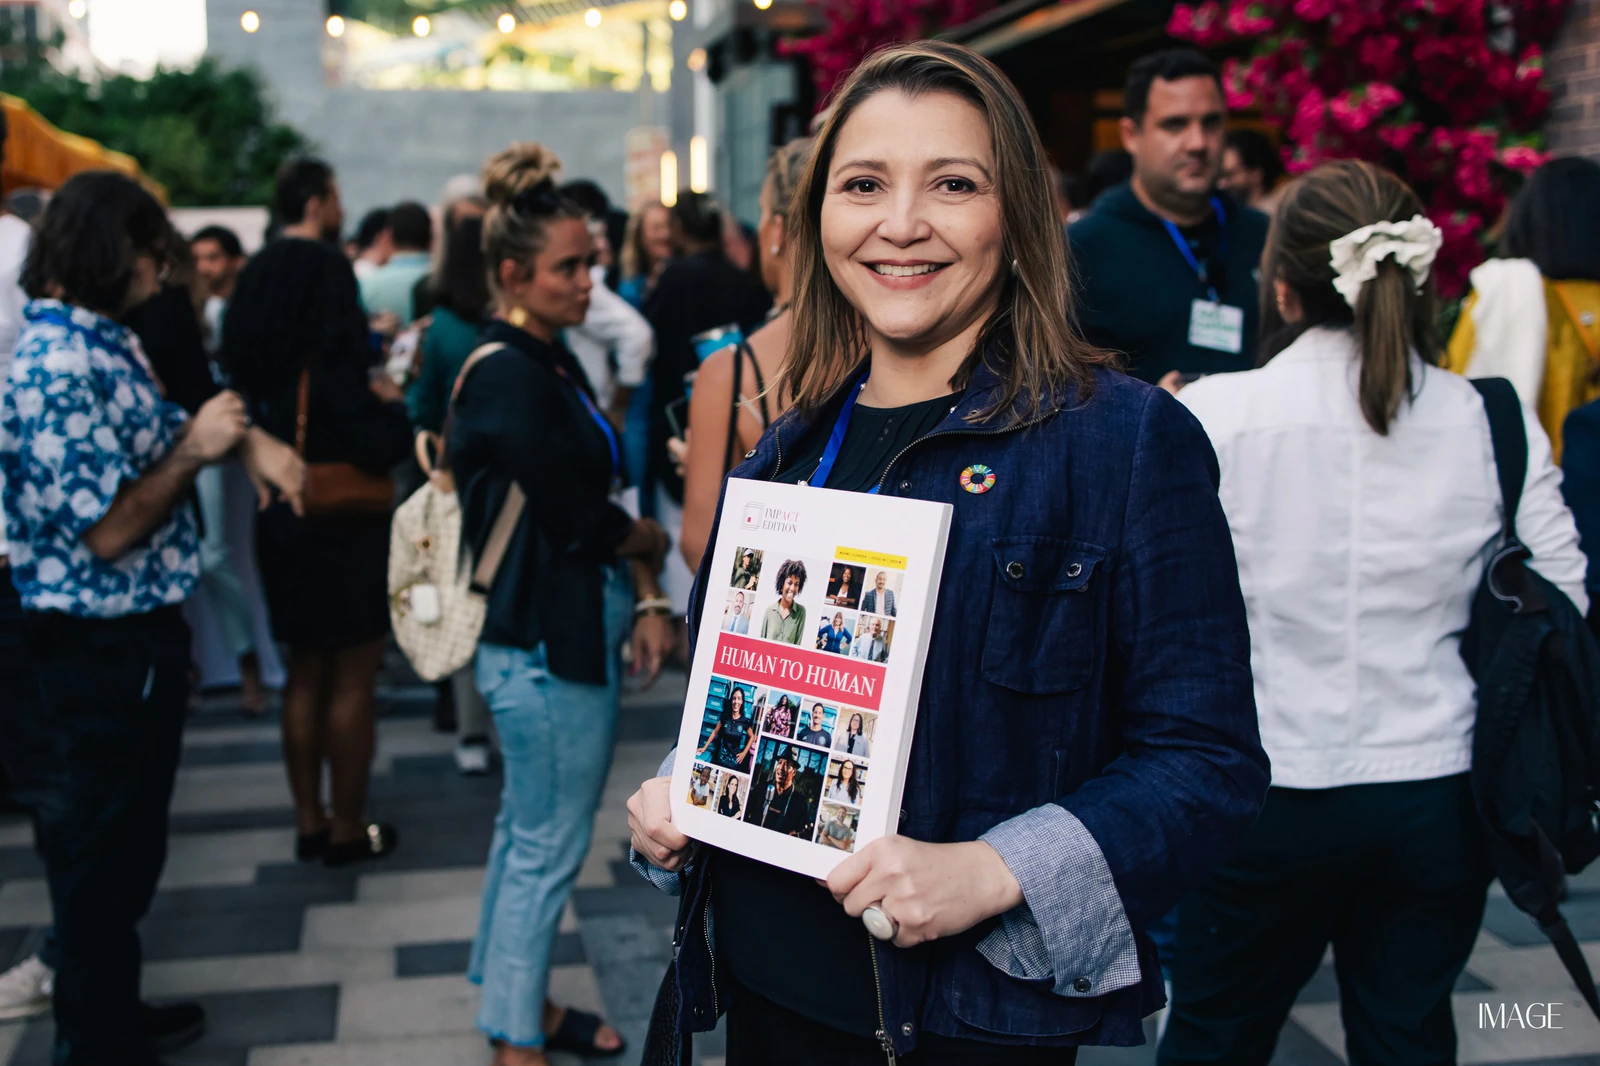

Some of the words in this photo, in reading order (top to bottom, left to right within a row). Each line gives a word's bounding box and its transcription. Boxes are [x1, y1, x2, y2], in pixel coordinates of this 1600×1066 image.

[765, 508, 799, 522] IMPACT
[762, 520, 797, 533] EDITION
[720, 646, 778, 675] HUMAN
[780, 658, 803, 680] TO
[805, 665, 876, 697] HUMAN
